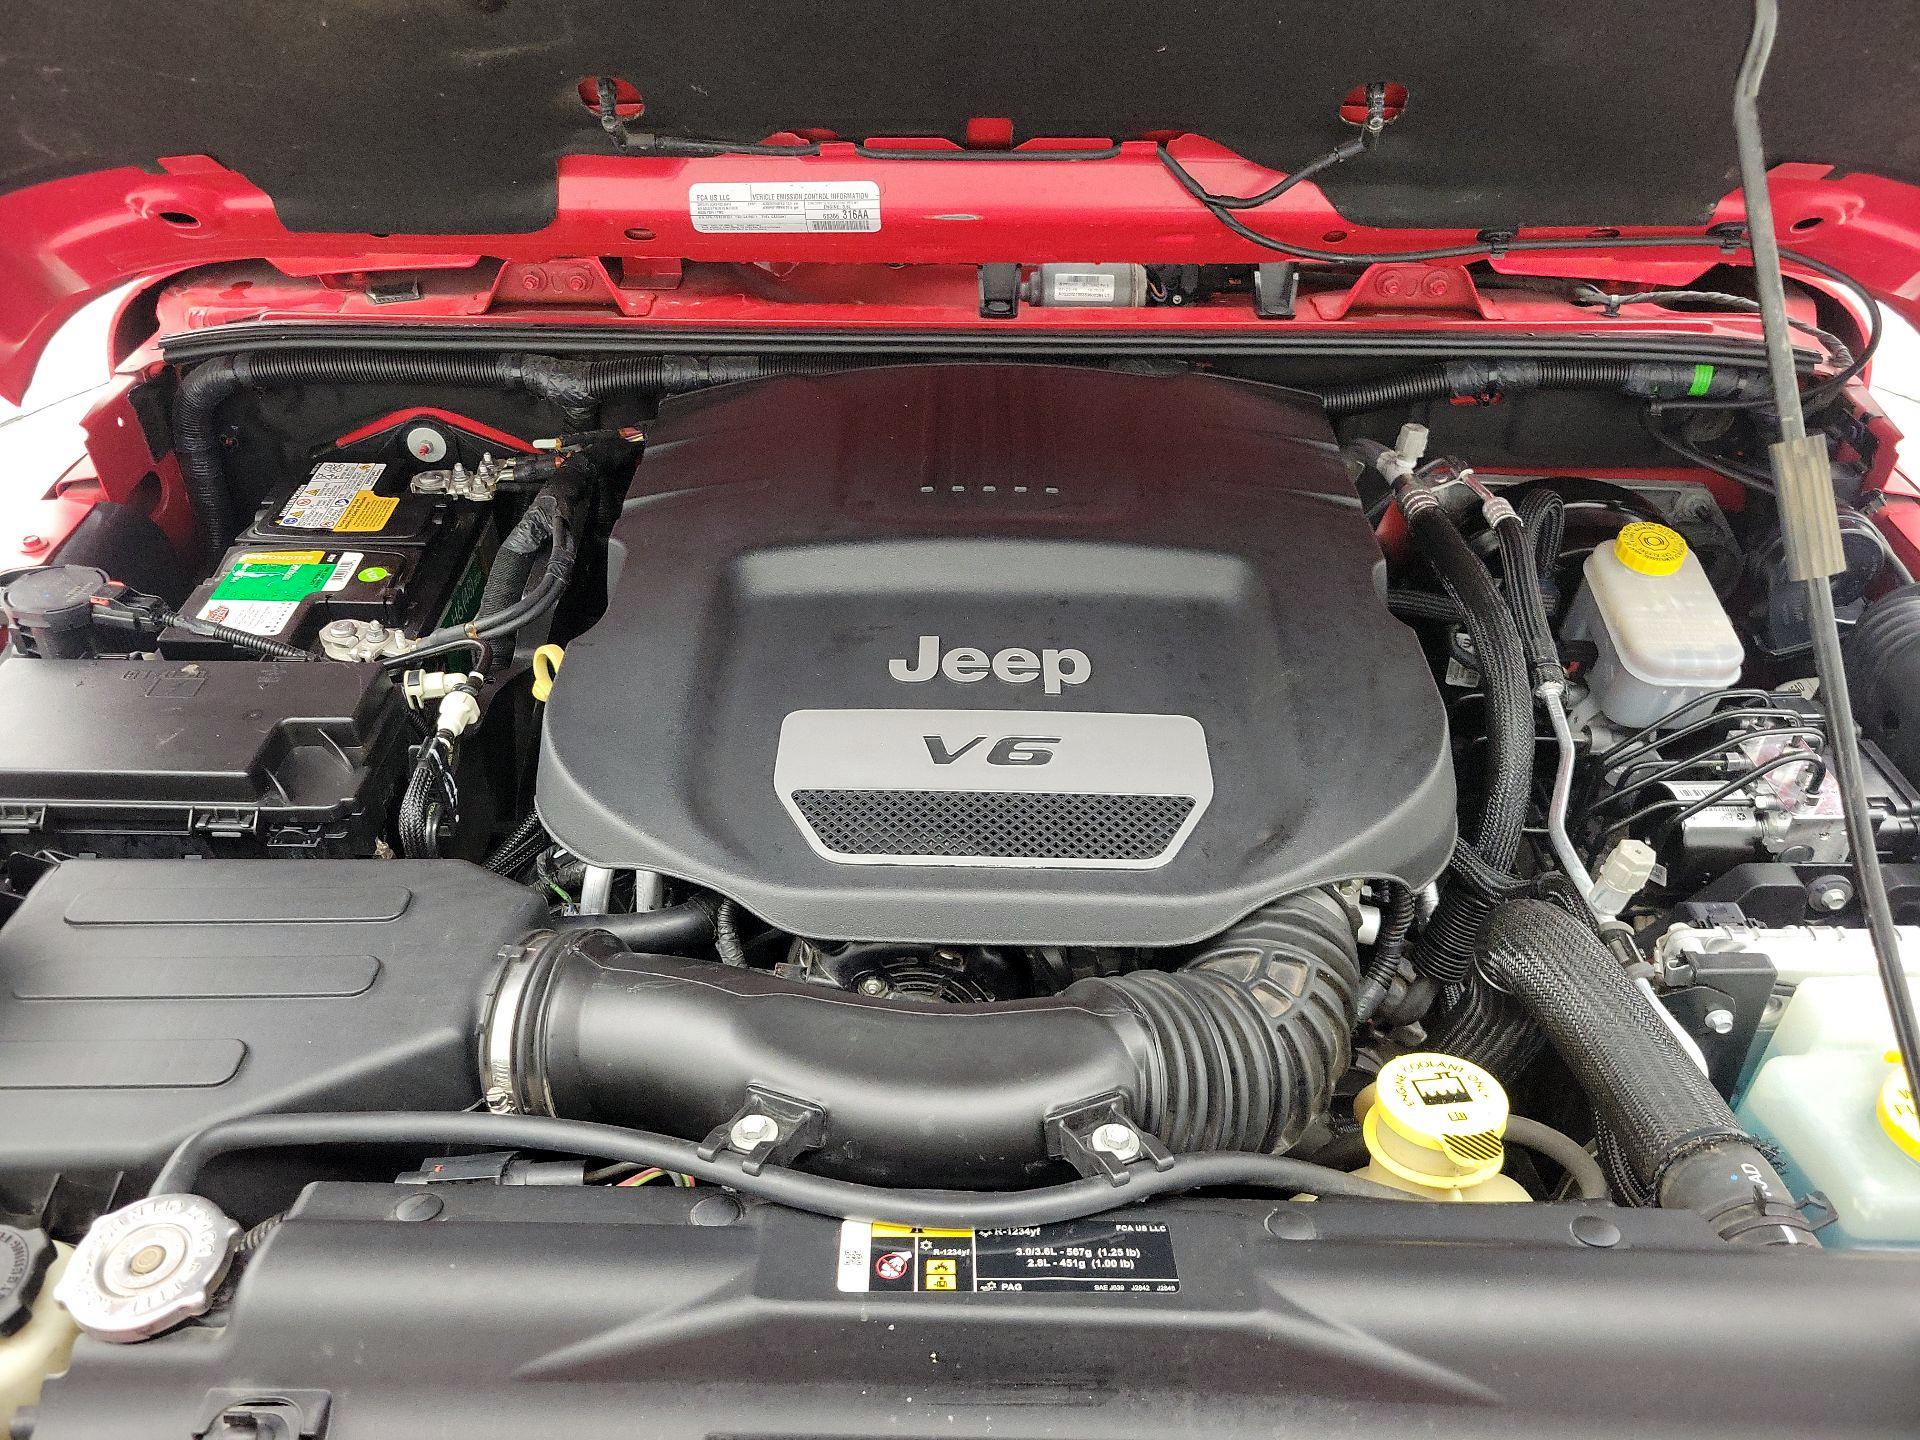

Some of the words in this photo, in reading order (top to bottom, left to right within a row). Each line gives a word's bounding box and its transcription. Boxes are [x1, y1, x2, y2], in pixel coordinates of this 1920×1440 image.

[842, 209, 869, 219] 316AA
[888, 635, 1092, 694] Jeep
[922, 734, 1063, 766] V6
[994, 1227, 1041, 1238] R-1234yf
[1115, 1224, 1134, 1232] FCA
[1135, 1224, 1147, 1232] US
[933, 1248, 970, 1257] R-1234yf
[1015, 1247, 1057, 1256] 3.0/3.6L
[1066, 1247, 1093, 1258] 567g
[1097, 1247, 1124, 1258] (1.25
[1125, 1247, 1140, 1258] lb)
[1027, 1258, 1051, 1267] 2.8L
[1059, 1258, 1086, 1269] 451g
[1091, 1258, 1118, 1269] (1.00
[1119, 1258, 1135, 1269] lb)
[1001, 1283, 1023, 1291] PAG
